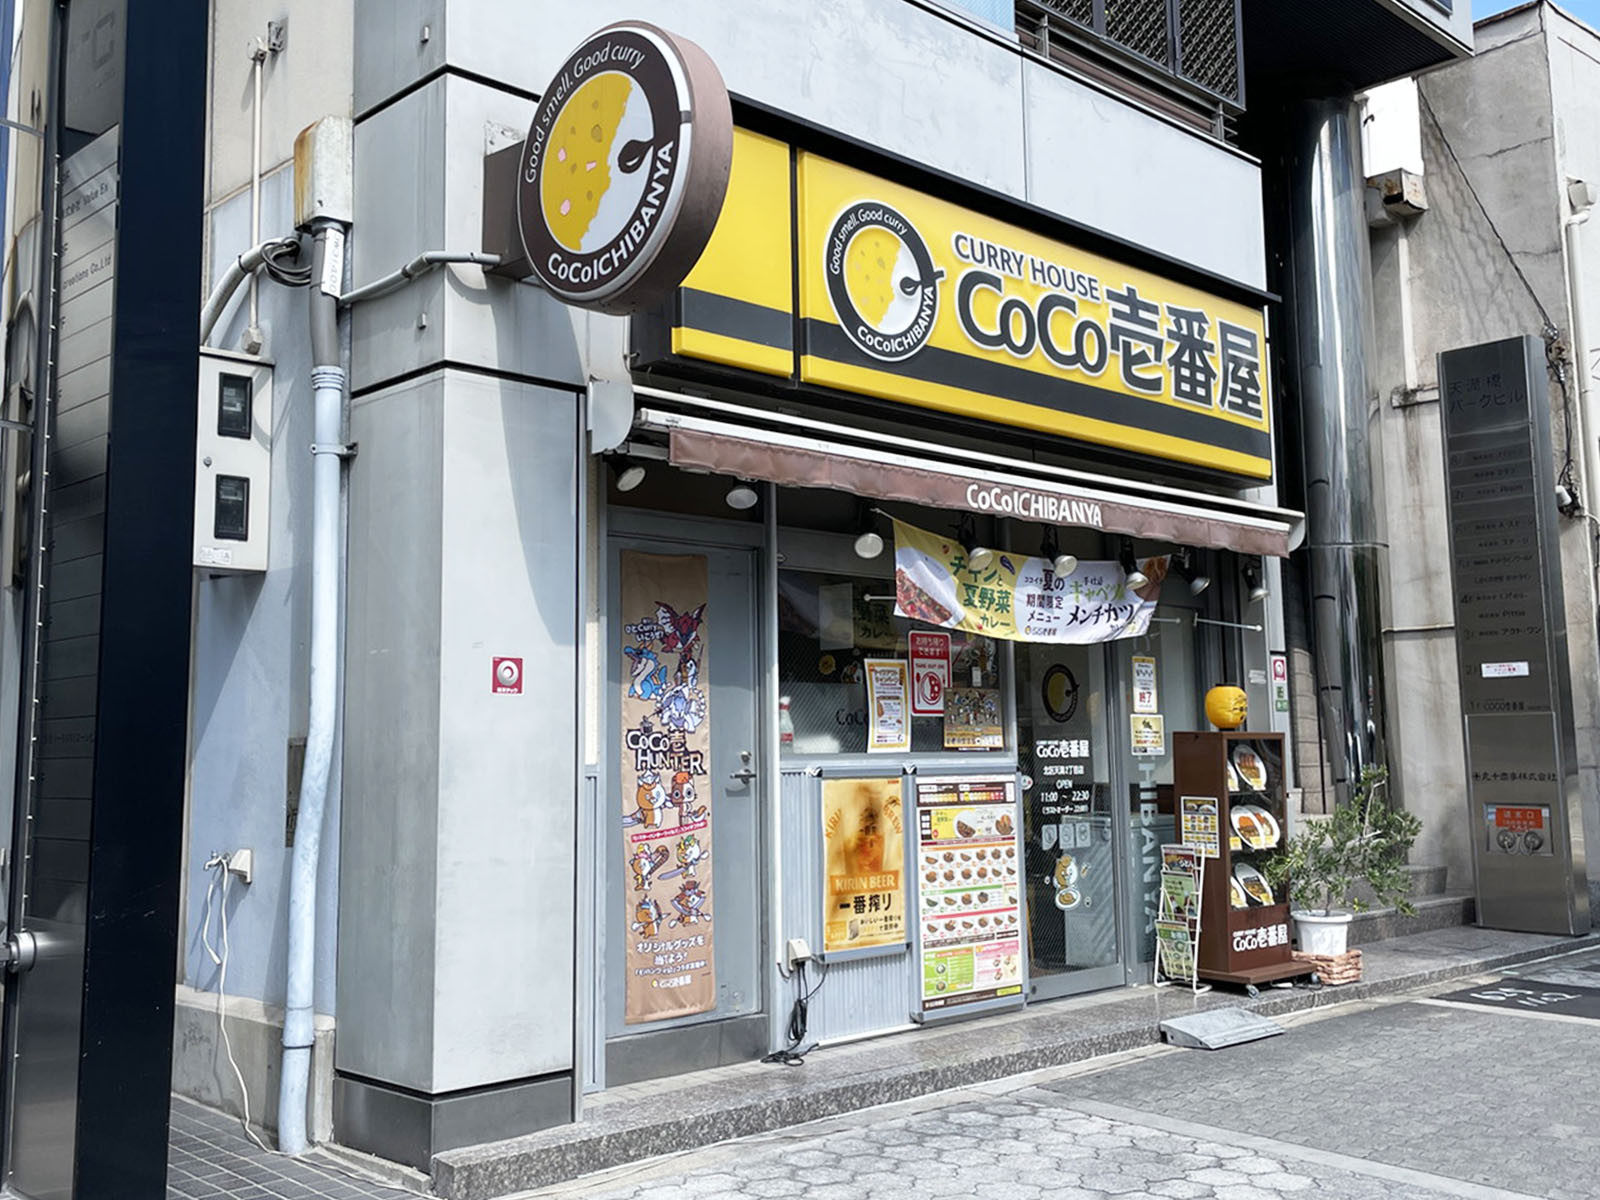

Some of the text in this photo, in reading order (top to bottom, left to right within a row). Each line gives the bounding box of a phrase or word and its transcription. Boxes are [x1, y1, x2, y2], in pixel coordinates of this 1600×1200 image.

[525, 126, 543, 183] Good
[573, 42, 608, 80] Good
[611, 45, 645, 70] curry
[547, 140, 673, 284] CoCoICHIBANYA
[829, 239, 842, 275] Good
[858, 208, 883, 224] Good
[883, 214, 907, 236] curry
[954, 233, 1099, 301] CURRY HOUSE
[957, 270, 1265, 421] CoCo壱番屋
[966, 484, 1103, 528] CoCoICHIBANYA
[963, 583, 1012, 613] 夏野菜
[980, 613, 1011, 628] カレー
[1027, 610, 1061, 622] メニュー
[1066, 603, 1134, 626] メンチカツ
[636, 748, 706, 776] HUNTER
[1040, 792, 1058, 802] 11:00
[1056, 779, 1073, 789] OPEN
[835, 873, 895, 891] KIRIN BEER
[839, 893, 892, 914] 一番搾り
[1233, 924, 1288, 952] CoCo壱番屋
